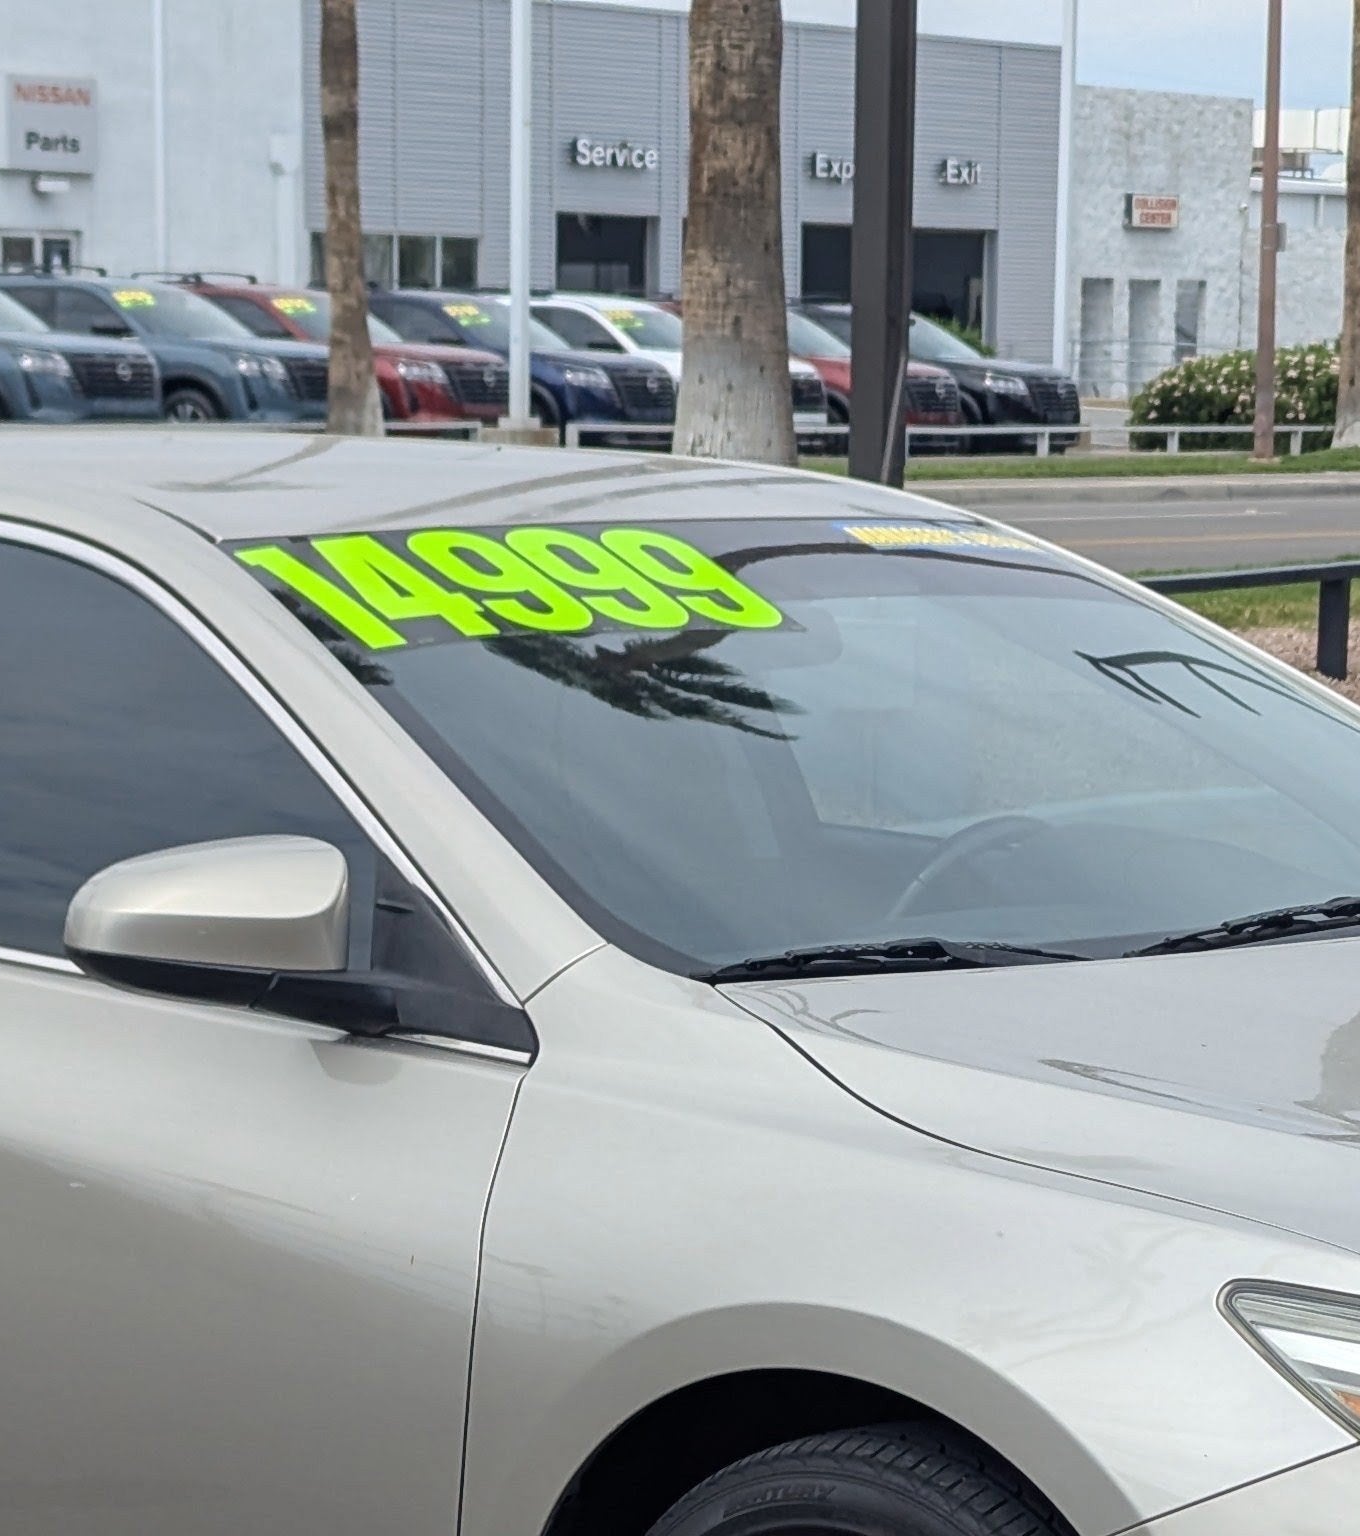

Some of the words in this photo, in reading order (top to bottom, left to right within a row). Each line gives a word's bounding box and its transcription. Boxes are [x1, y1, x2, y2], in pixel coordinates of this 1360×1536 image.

[25, 131, 79, 153] Parts
[576, 138, 657, 169] Service
[946, 157, 981, 185] Exit
[233, 528, 783, 650] 14999
